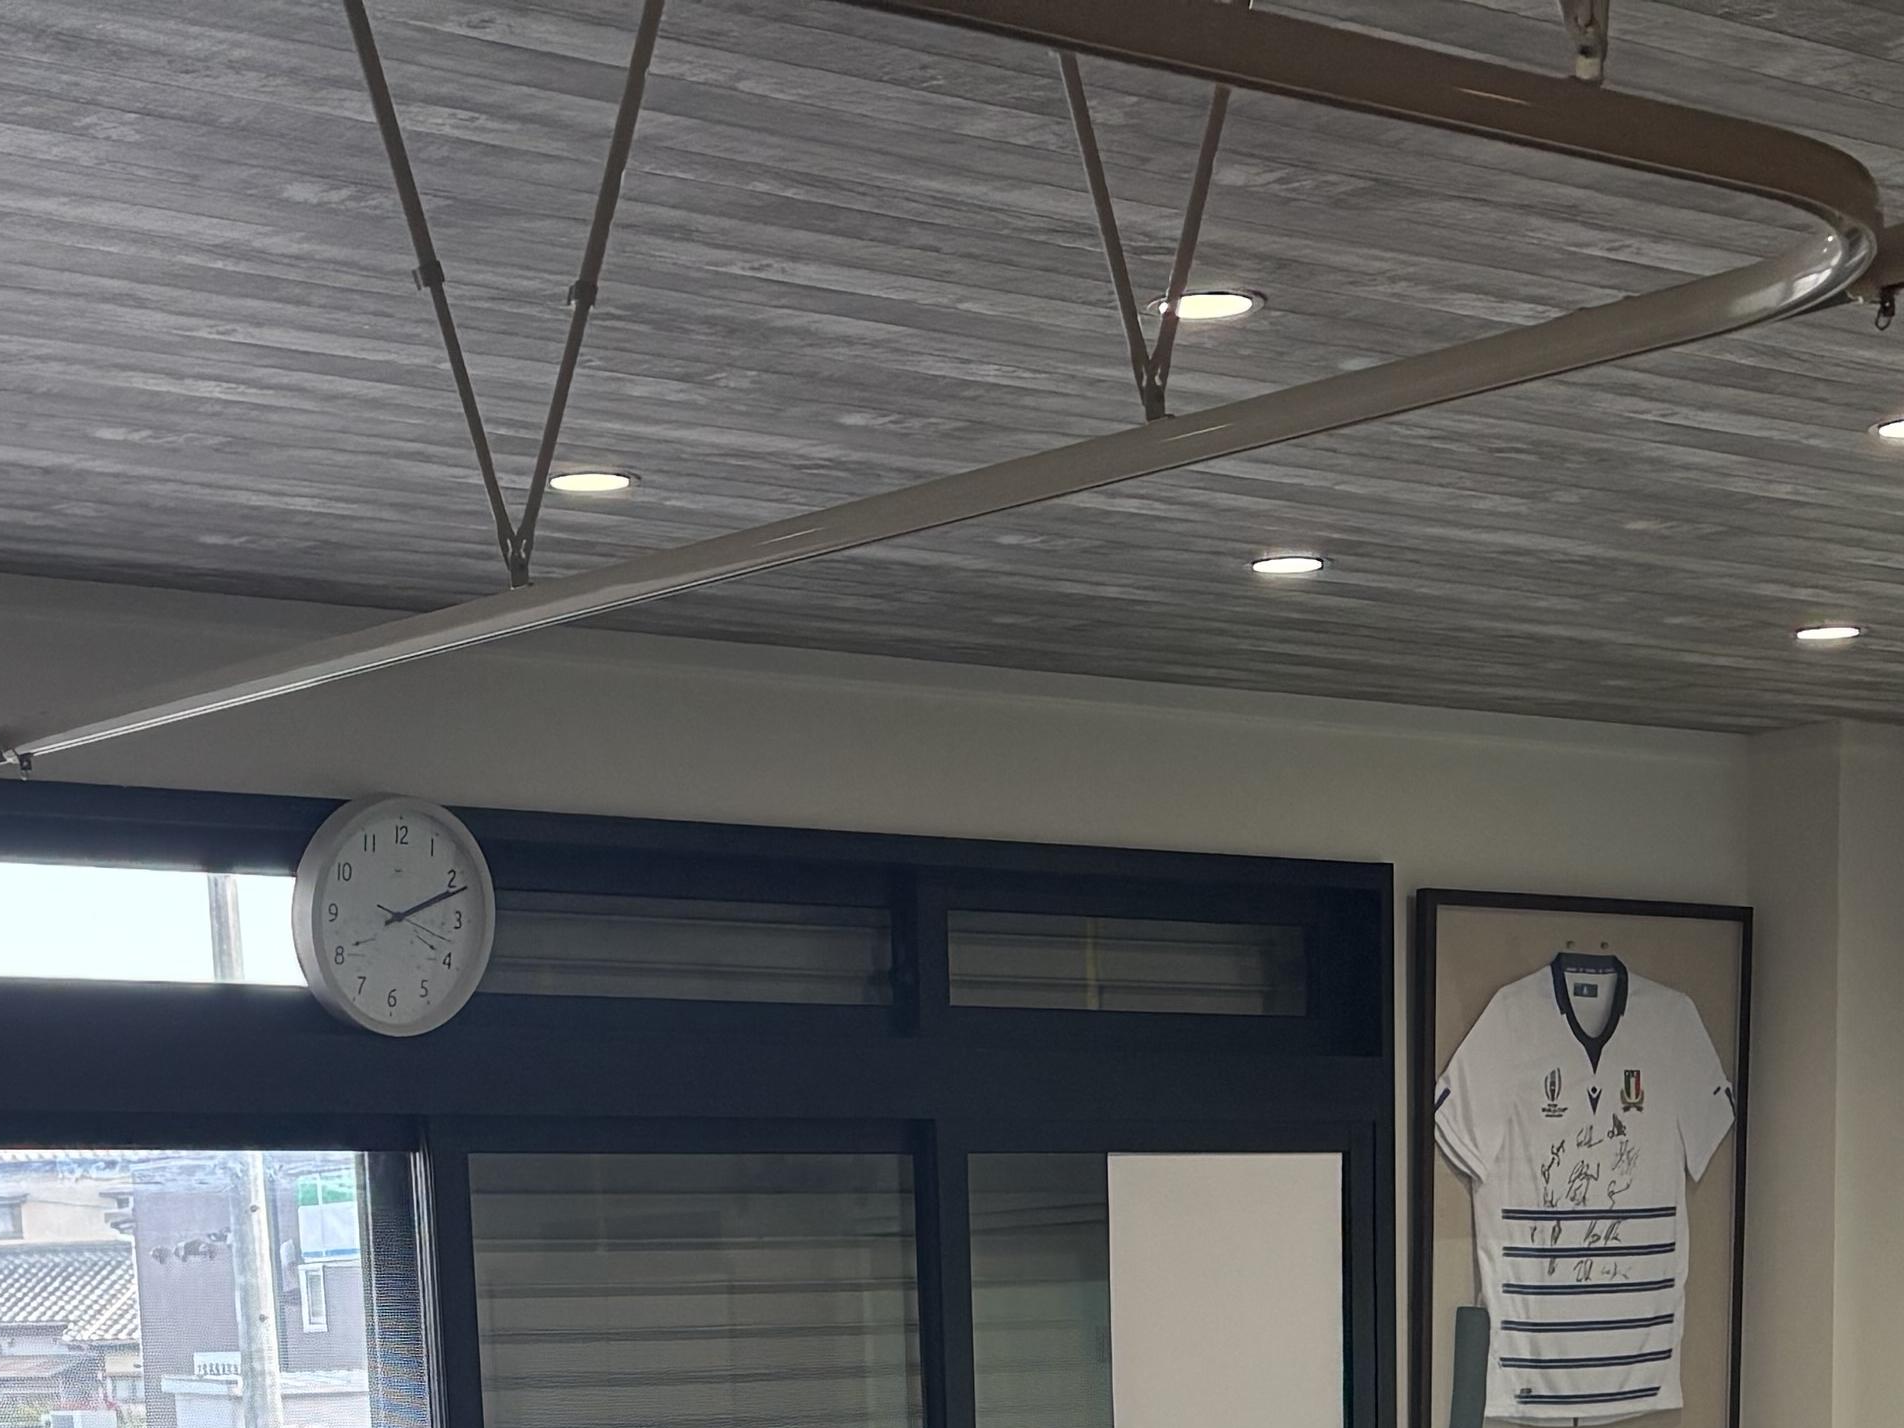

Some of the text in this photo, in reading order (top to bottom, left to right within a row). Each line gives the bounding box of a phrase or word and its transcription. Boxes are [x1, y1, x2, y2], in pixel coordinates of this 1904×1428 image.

[363, 833, 376, 853] 11
[394, 825, 409, 845] 12
[430, 837, 434, 857] 1
[336, 862, 352, 881] 10
[447, 869, 457, 888] 2
[328, 903, 339, 922] 9
[453, 910, 462, 930] 3
[334, 945, 345, 965] 8
[442, 951, 452, 970] 4
[357, 976, 367, 995] 7
[419, 979, 429, 998] 5
[387, 988, 397, 1008] 6
